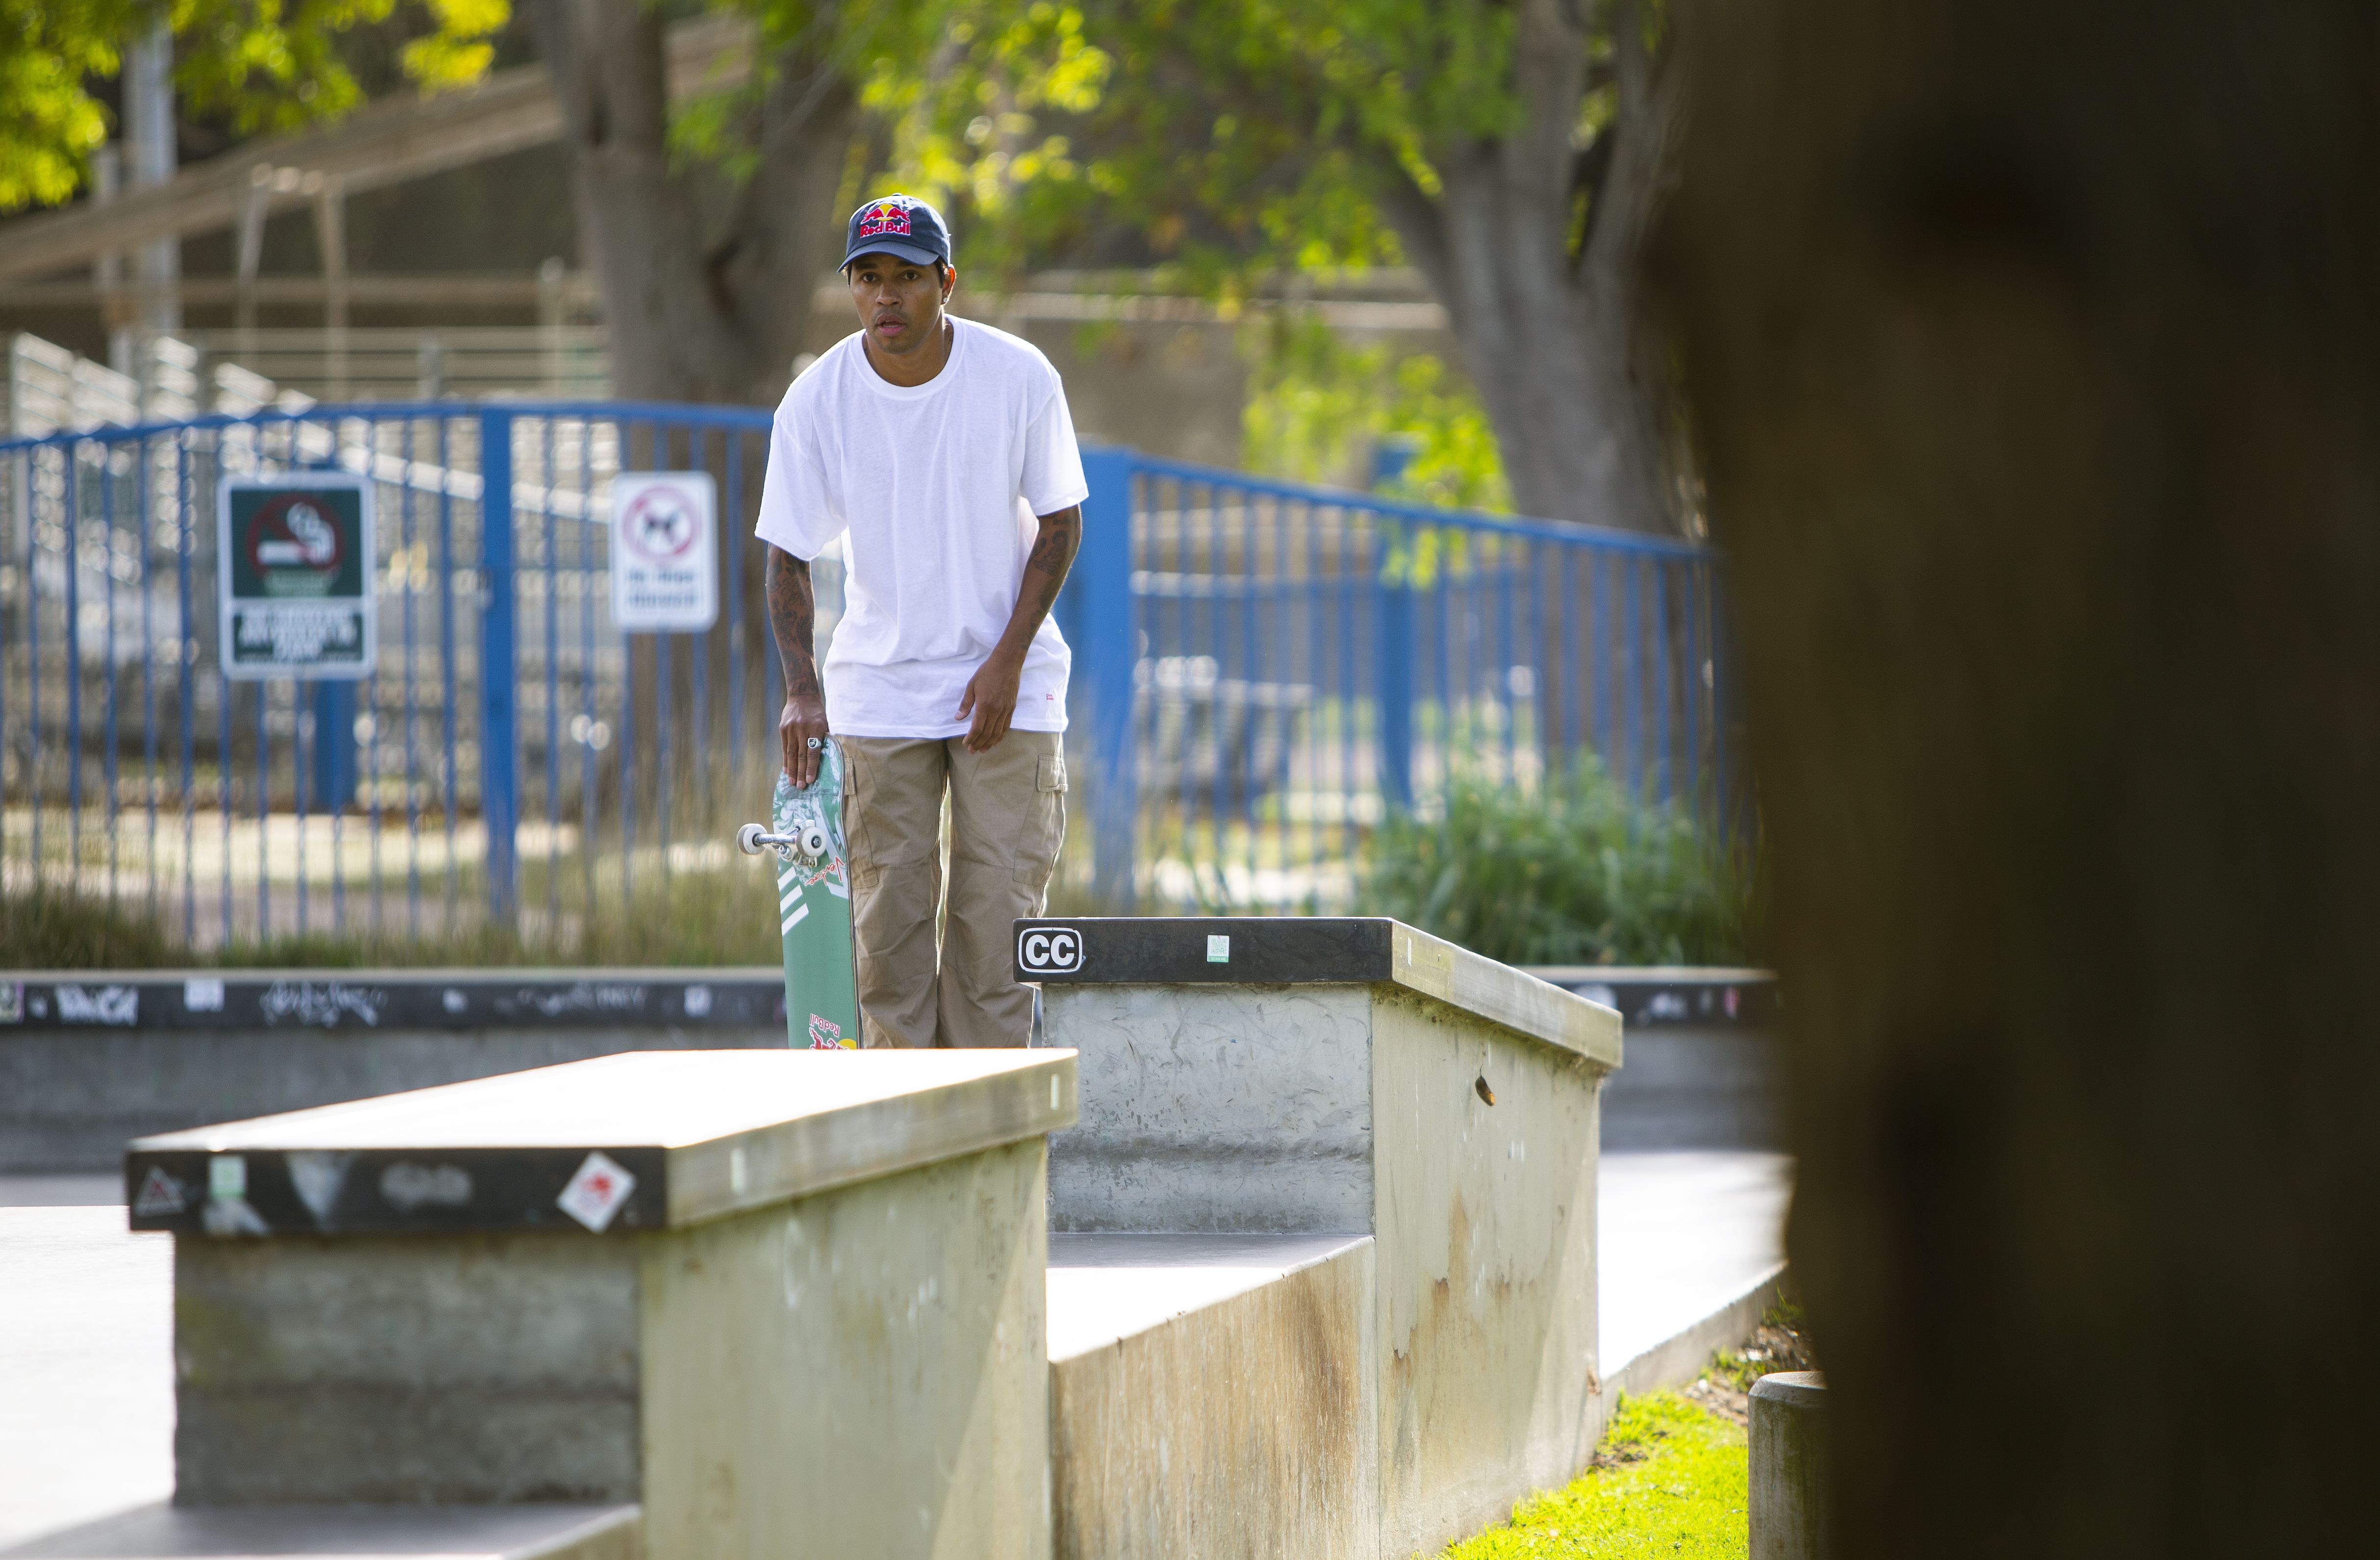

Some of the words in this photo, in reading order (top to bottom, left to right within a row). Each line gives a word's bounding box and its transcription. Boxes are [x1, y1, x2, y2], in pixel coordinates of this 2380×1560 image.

[860, 221, 883, 237] Red
[884, 221, 910, 235] Bull
[805, 856, 845, 886] Venture
[1025, 935, 1075, 966] CC
[809, 1013, 824, 1031] Bull
[823, 1020, 840, 1038] Red
